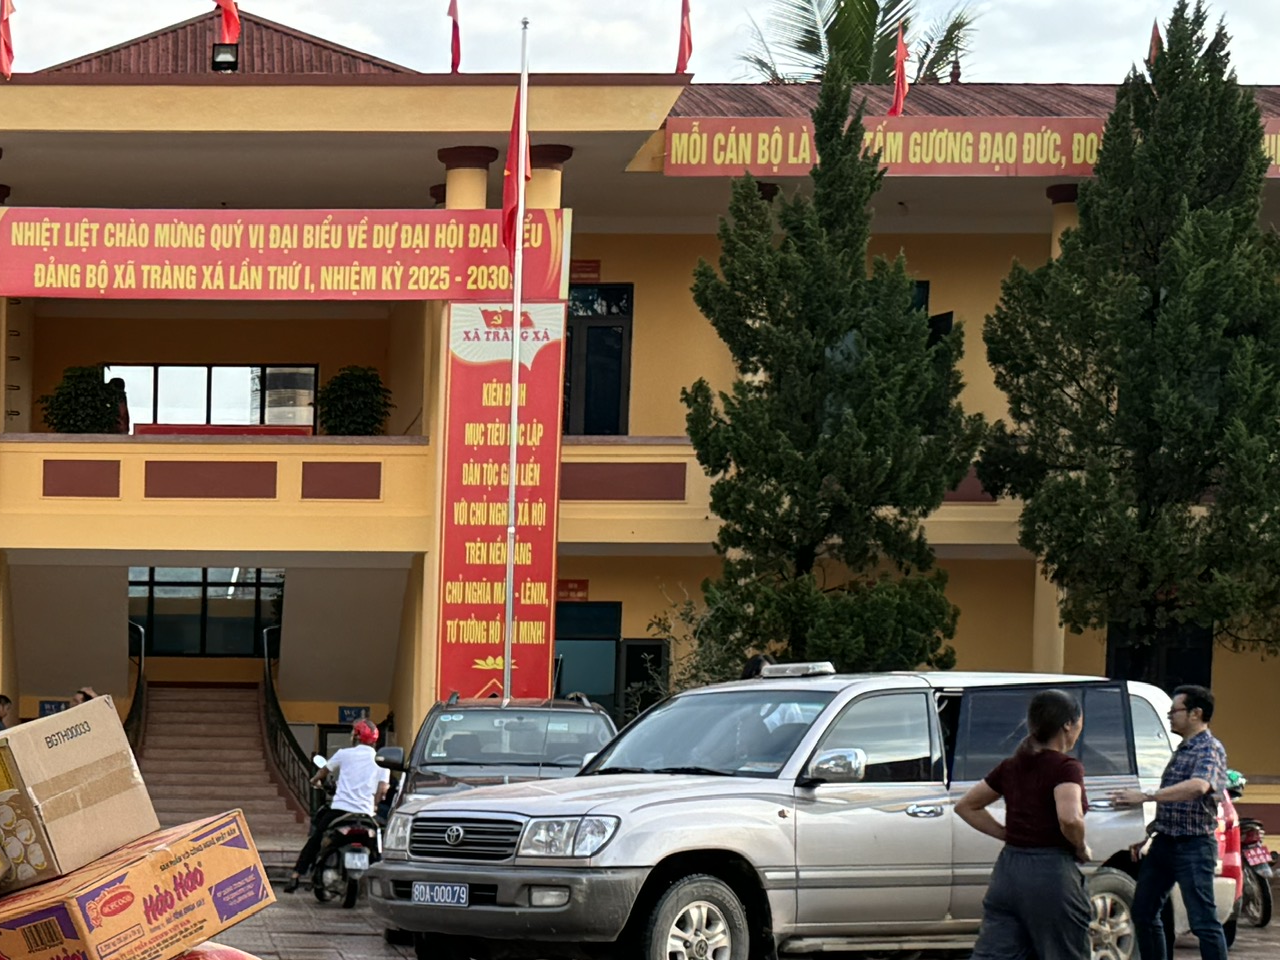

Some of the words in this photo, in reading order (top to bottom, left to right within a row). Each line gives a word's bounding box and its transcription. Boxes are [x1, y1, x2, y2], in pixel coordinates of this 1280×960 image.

[671, 122, 707, 165] MỖI
[713, 126, 751, 165] CÁN
[757, 126, 783, 173] BỘ
[788, 125, 811, 164] LÀ
[909, 128, 973, 164] GƯƠNG
[978, 132, 1017, 171] ĐẠO
[1022, 126, 1066, 169] ĐỨC,
[11, 217, 60, 252] NHIỆT
[65, 218, 99, 253] LIỆT
[104, 218, 149, 248] CHÀO
[154, 218, 206, 249] MỪNG
[210, 219, 244, 251] QUÝ
[248, 224, 265, 254] VỊ
[269, 224, 298, 254] ĐẠI
[302, 214, 342, 249] BIỂU
[347, 216, 368, 249] VỀ
[372, 221, 398, 254] DỰ
[400, 224, 430, 254] ĐẠI
[435, 218, 464, 254] HỘI
[468, 224, 498, 254] ĐẠI
[33, 256, 81, 289] ĐẢNG
[85, 259, 109, 294] BỘ
[113, 260, 136, 289] XÃ
[141, 260, 197, 290] TRÀNG
[201, 260, 225, 290] XÁ
[229, 257, 263, 290] LẦN
[267, 261, 302, 290] THỨ
[320, 261, 376, 295] NHIỆM
[381, 261, 404, 290] KỲ
[408, 265, 450, 290] 2025
[463, 328, 480, 341] XÃ
[484, 328, 529, 341] TRÀG
[532, 328, 550, 341] XÁ
[482, 378, 503, 407] KIÊN
[464, 423, 485, 451] MỤC
[487, 418, 506, 446] TIÊU
[526, 418, 544, 452] LẬP
[462, 458, 481, 486] DÂN
[483, 458, 499, 492] TỘC
[531, 497, 547, 532] HỘI
[465, 537, 488, 565] TRÊN
[513, 535, 532, 566] ẢNG
[465, 577, 492, 605] NGHĨA
[45, 720, 92, 749] BGTH00033
